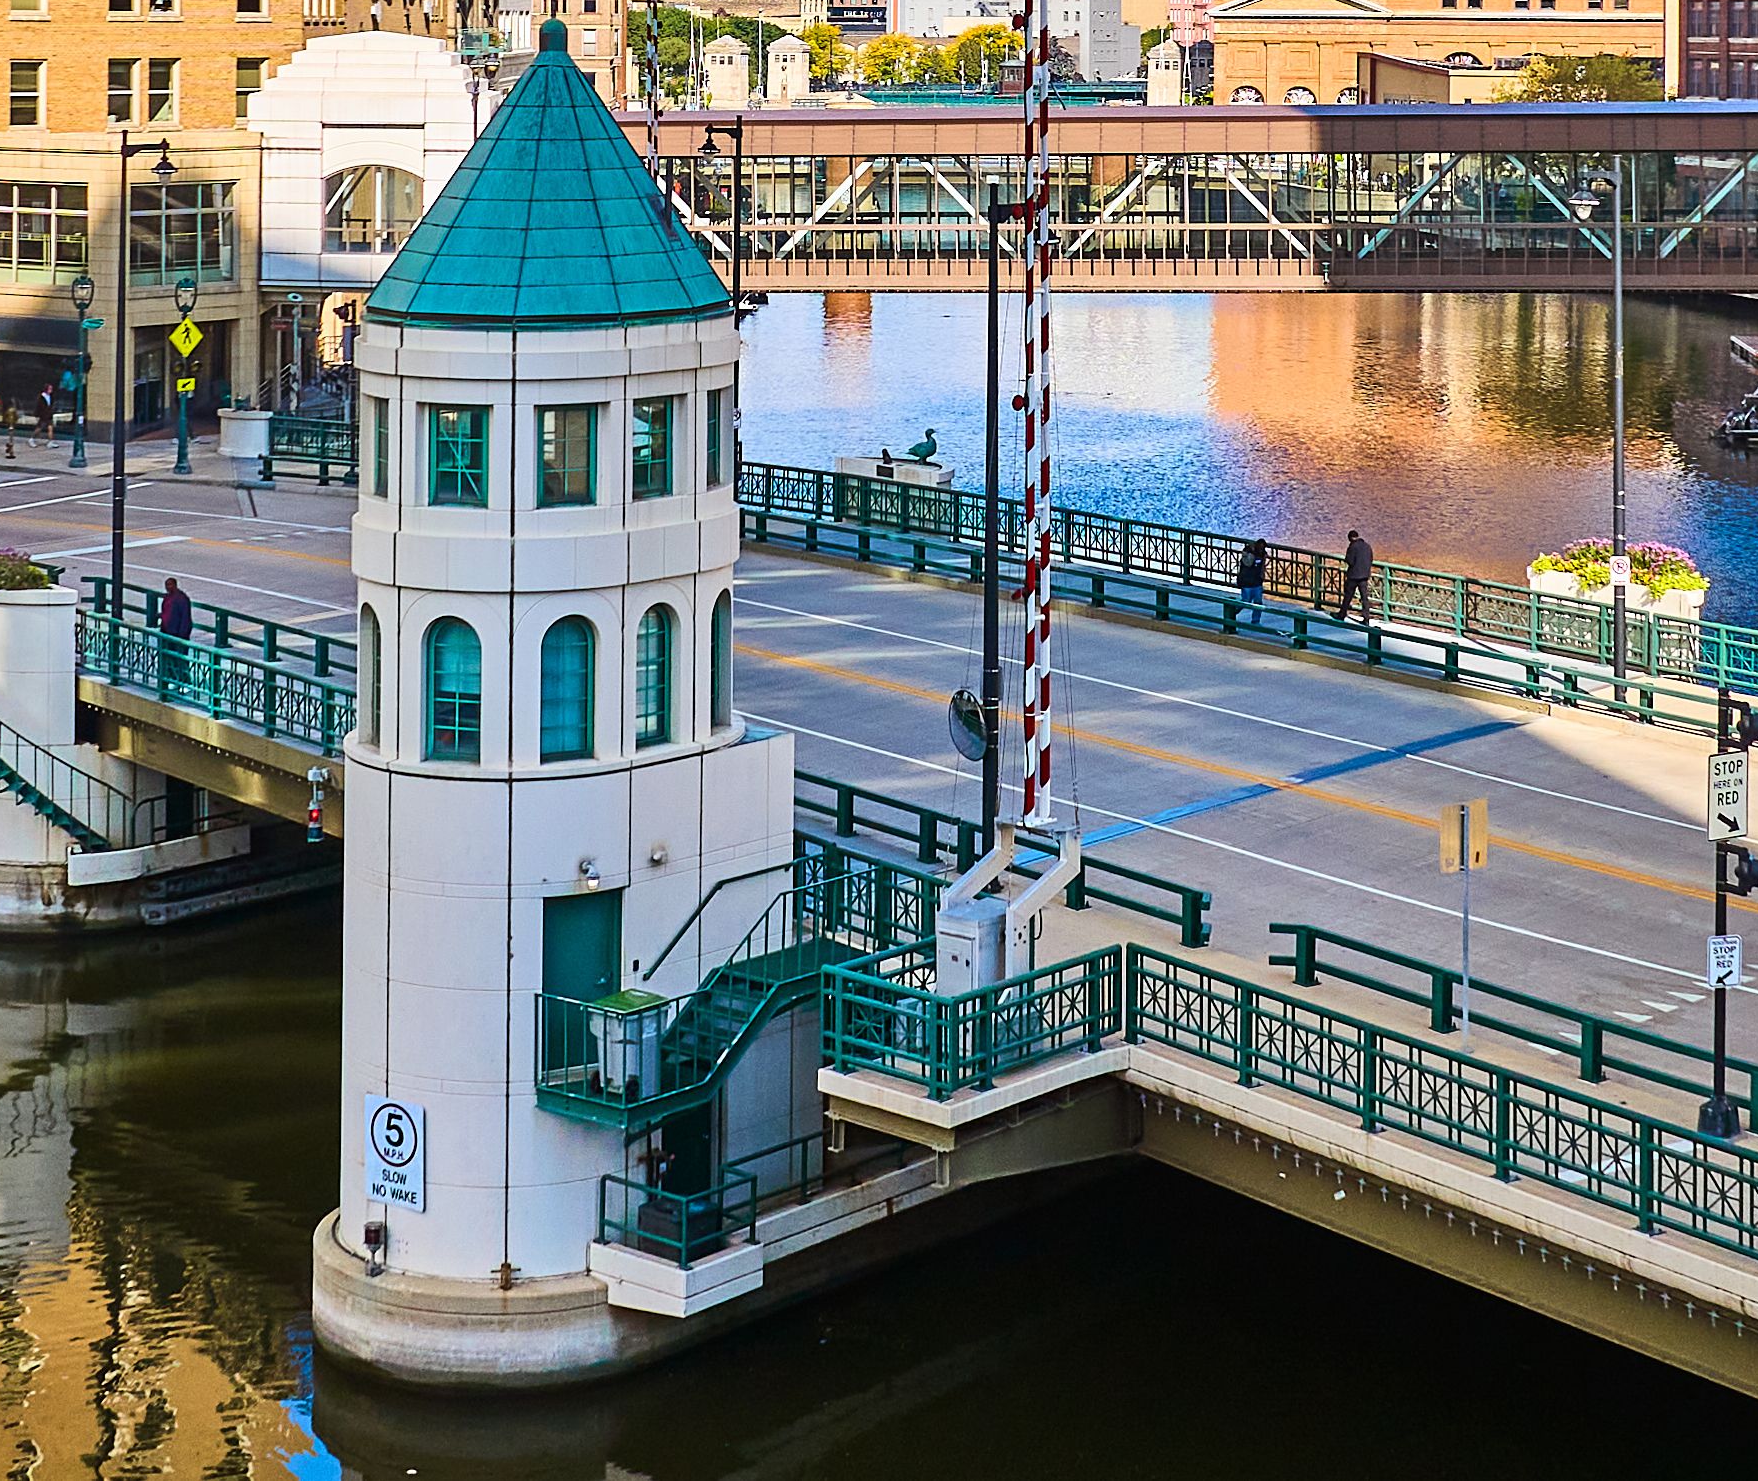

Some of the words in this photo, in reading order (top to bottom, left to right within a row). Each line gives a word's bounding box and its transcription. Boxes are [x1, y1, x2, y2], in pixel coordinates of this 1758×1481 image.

[1714, 759, 1744, 777] STOP
[1713, 779, 1731, 790] HERE
[1733, 777, 1743, 787] ON
[1717, 790, 1740, 807] RED
[1713, 946, 1737, 955] STOP
[1716, 960, 1733, 969] RED
[385, 1112, 405, 1148] 5
[381, 1168, 408, 1186] SLOW
[372, 1182, 388, 1198] NO
[389, 1186, 418, 1205] WAKE
